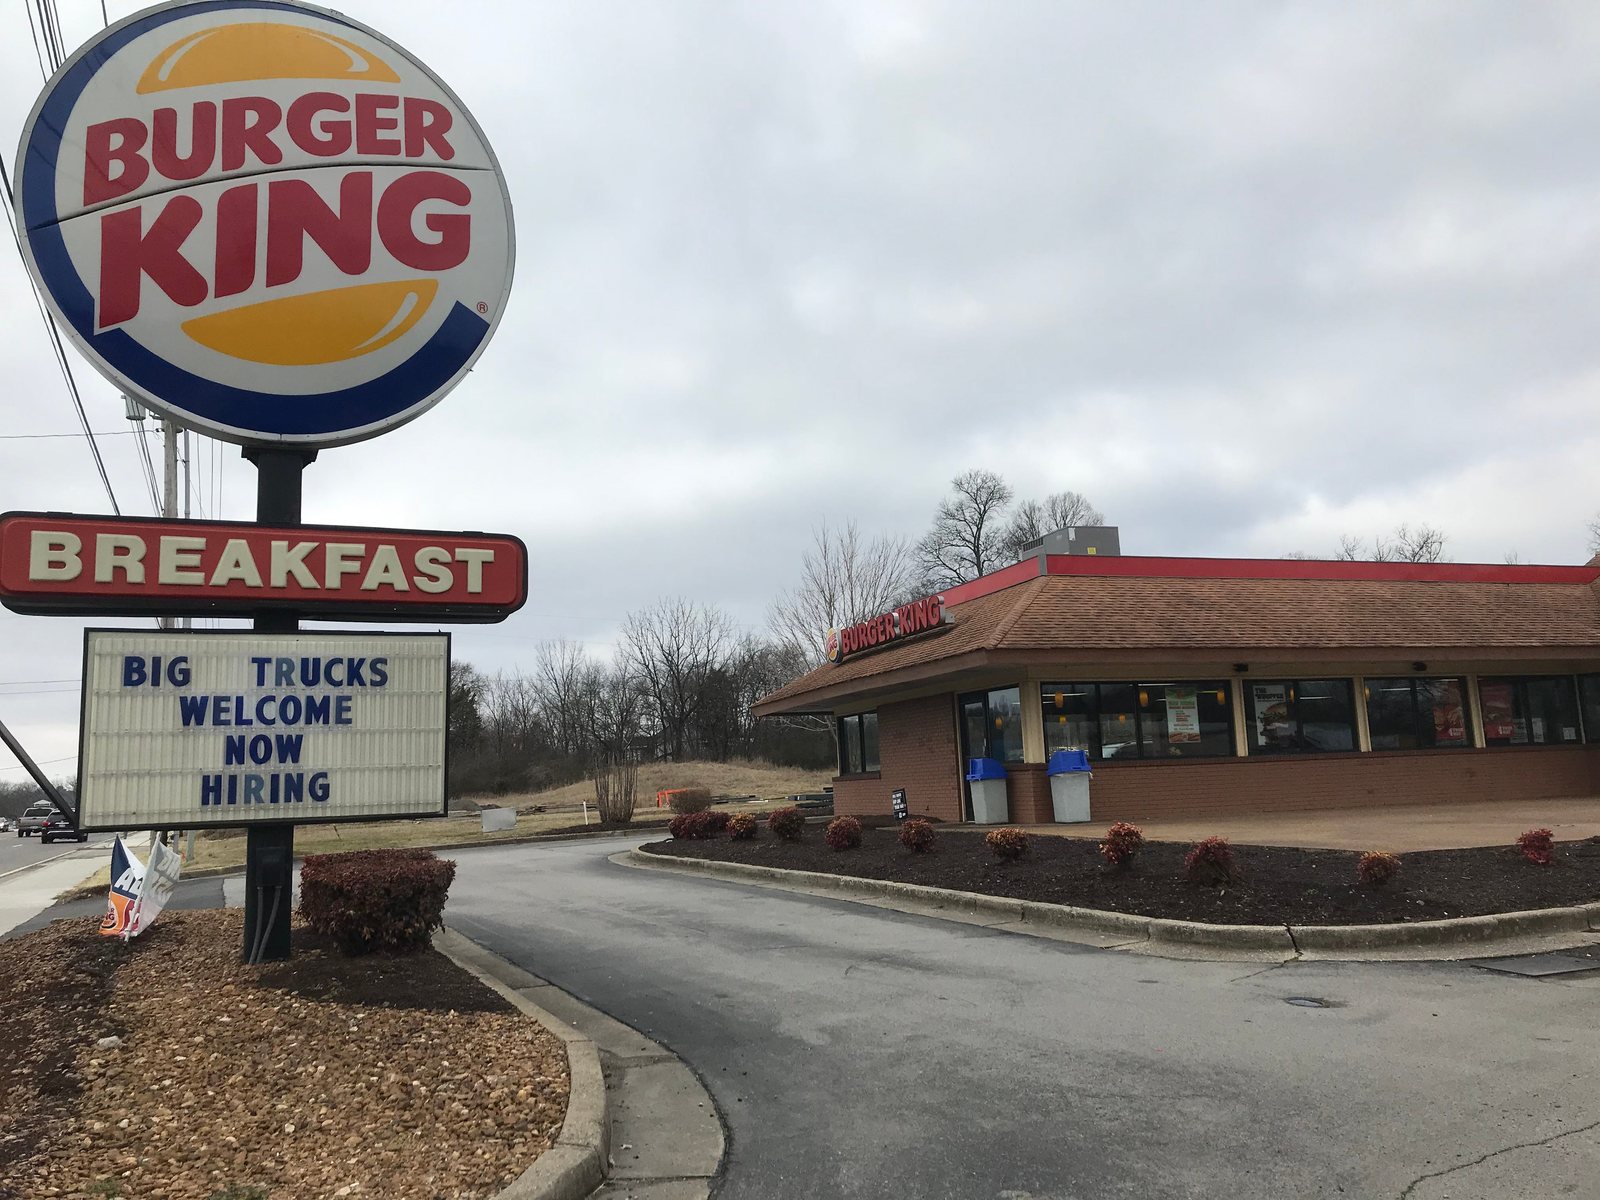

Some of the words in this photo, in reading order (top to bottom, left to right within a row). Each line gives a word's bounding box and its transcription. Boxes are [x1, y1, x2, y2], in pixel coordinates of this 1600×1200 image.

[83, 91, 456, 208] BURGER
[98, 171, 472, 329] KING
[28, 529, 495, 594] BREAKFAST
[841, 612, 896, 654] BURGER
[896, 595, 940, 635] KING
[122, 655, 191, 688] BIG
[251, 655, 389, 688] TRUCKS
[179, 694, 353, 728] WELCOME
[225, 733, 304, 766] NOW
[200, 771, 331, 807] HIRING
